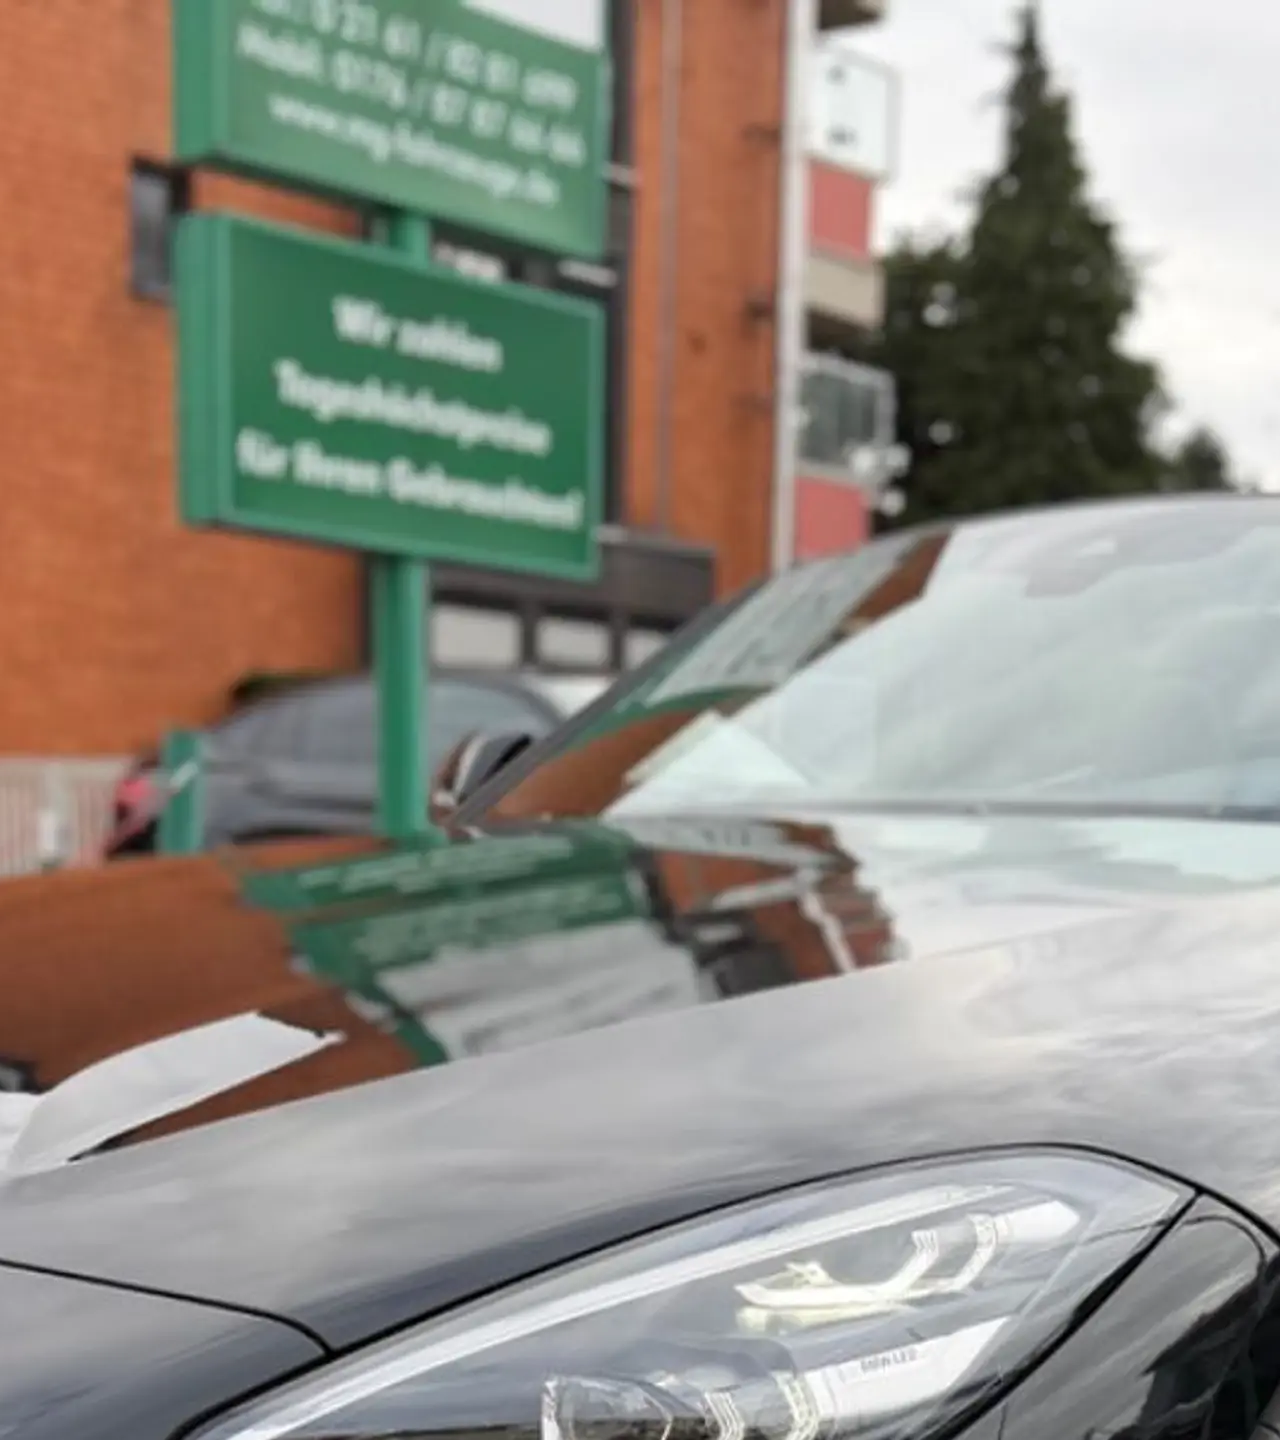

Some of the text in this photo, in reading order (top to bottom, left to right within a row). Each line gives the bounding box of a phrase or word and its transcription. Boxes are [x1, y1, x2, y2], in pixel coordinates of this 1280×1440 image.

[332, 295, 503, 373] Wir zahlen
[236, 427, 287, 480] für
[293, 440, 382, 495] Ihren
